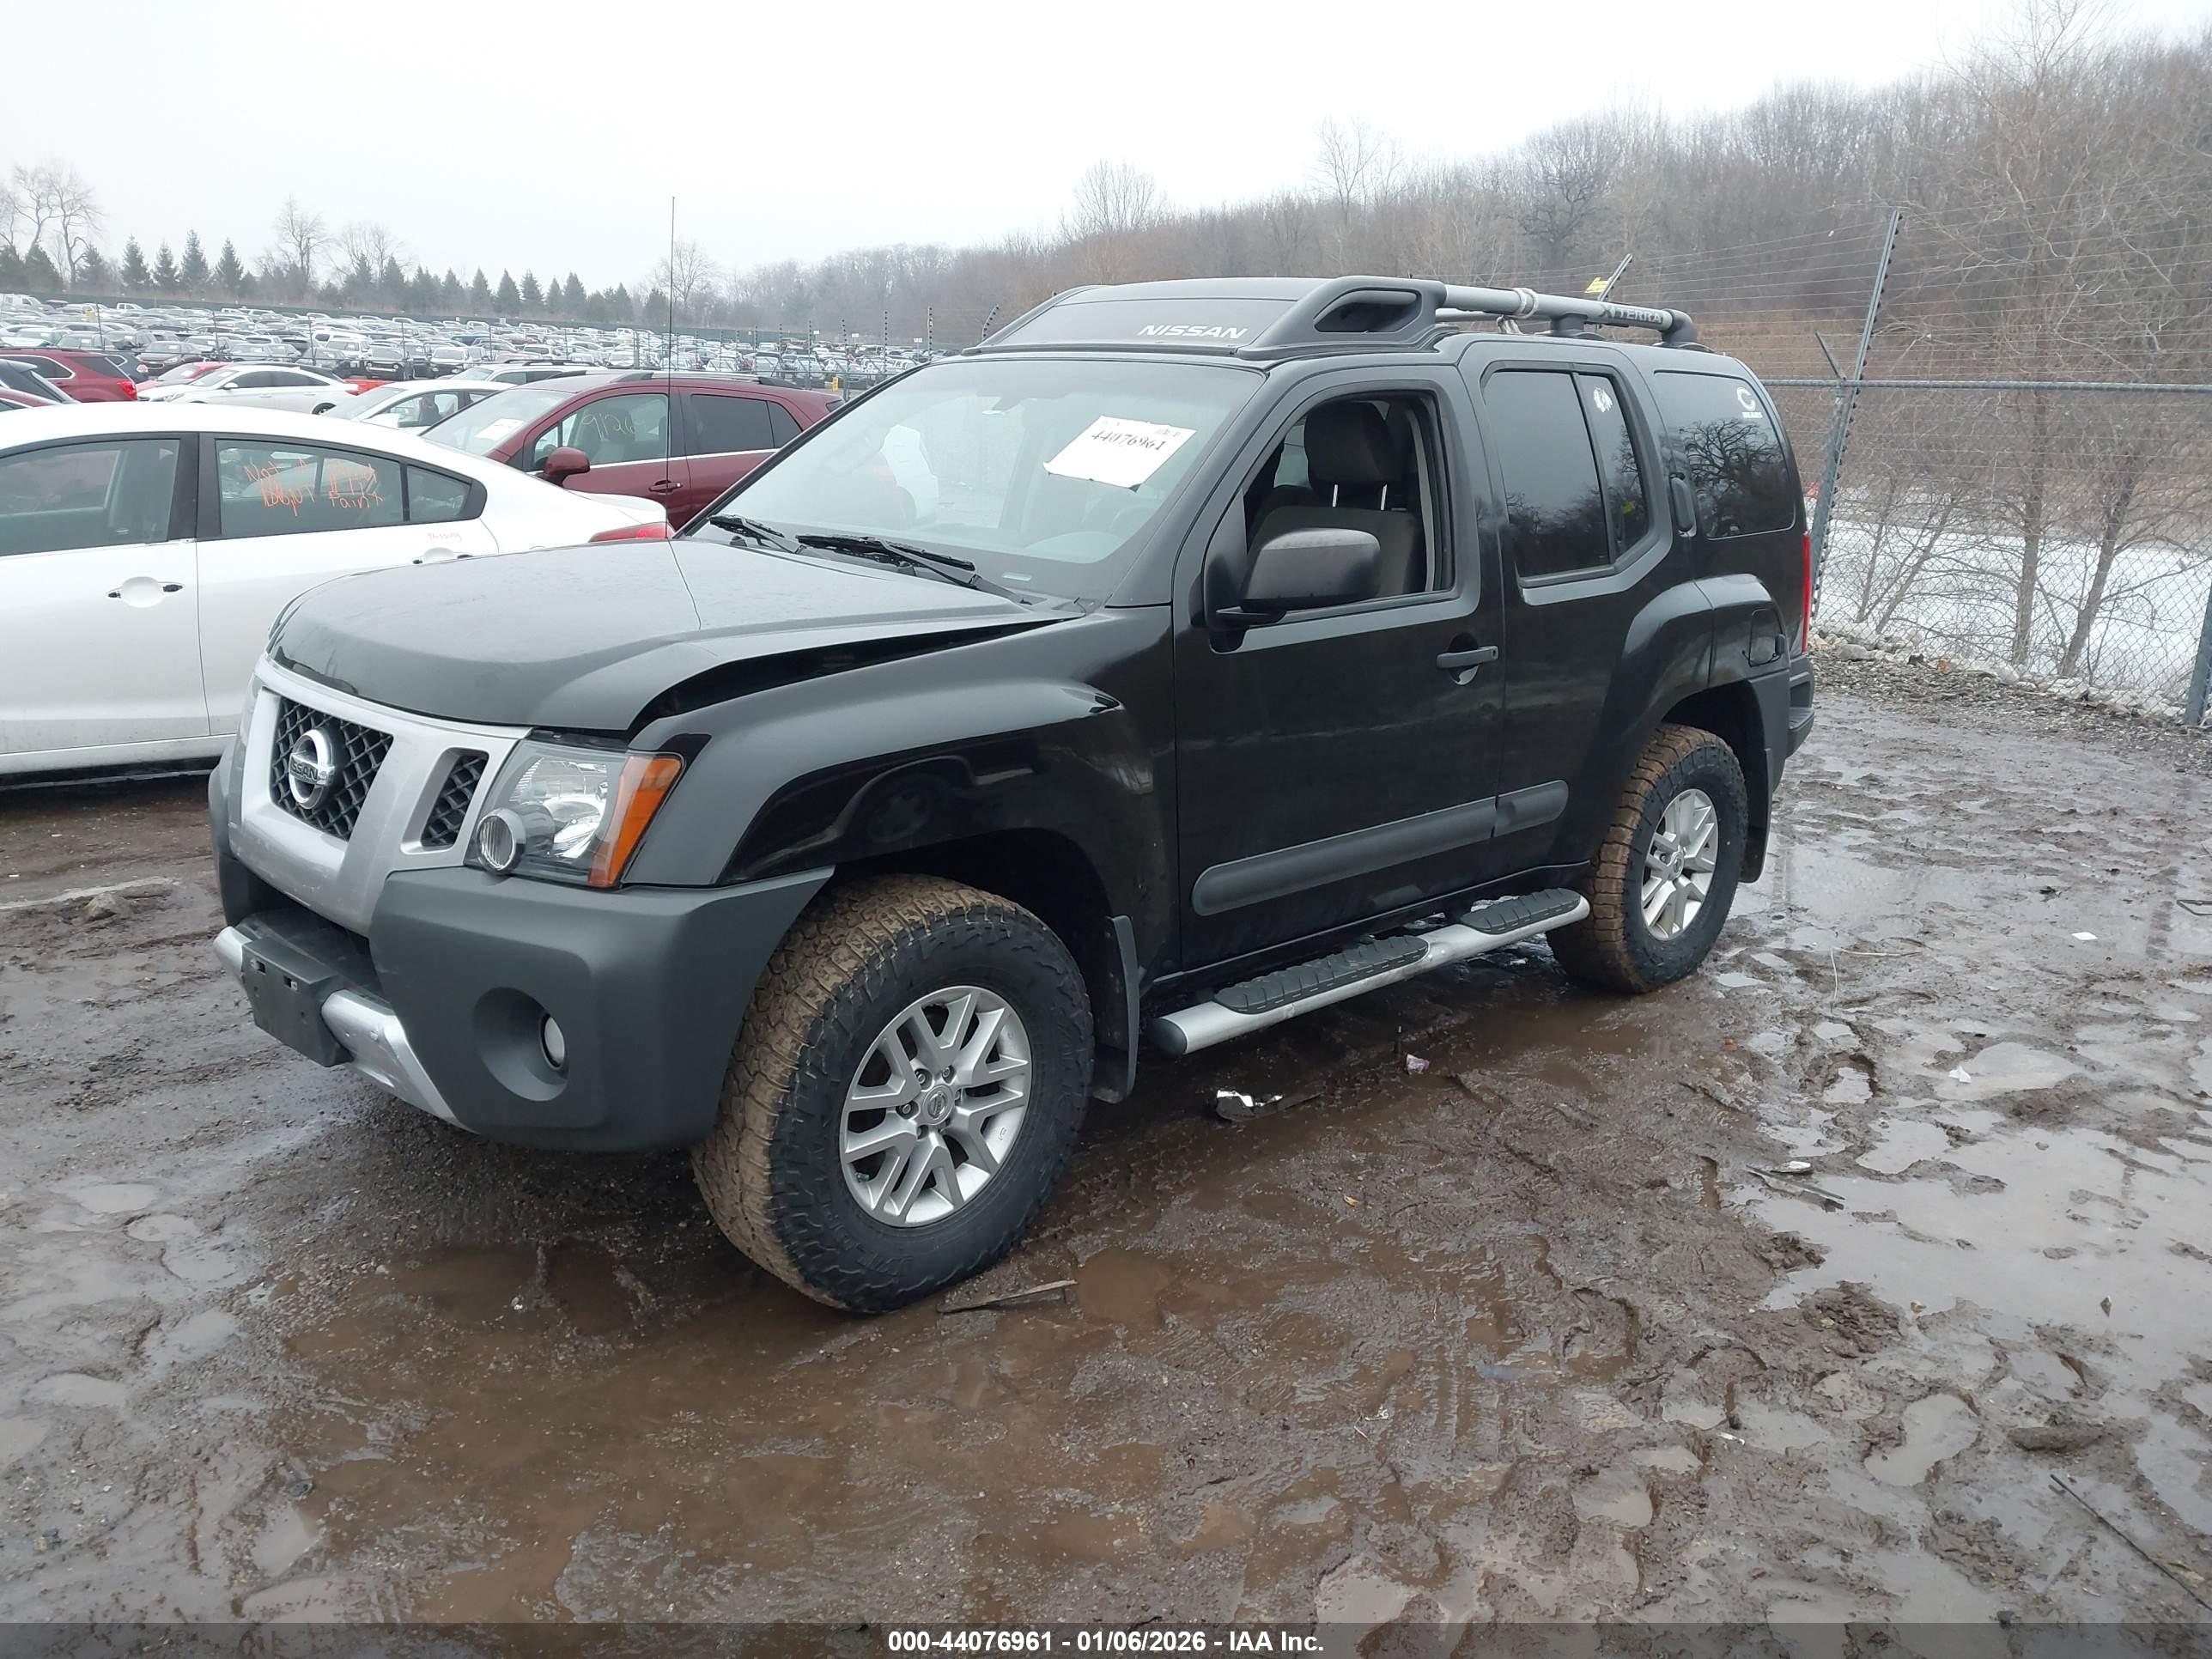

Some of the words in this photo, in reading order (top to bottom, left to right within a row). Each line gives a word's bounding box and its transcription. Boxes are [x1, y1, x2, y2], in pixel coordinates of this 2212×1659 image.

[1600, 304, 1663, 324] XTERRA
[1137, 325, 1249, 339] NISSAN
[1091, 430, 1167, 451] 44076961
[292, 755, 319, 782] SSAN
